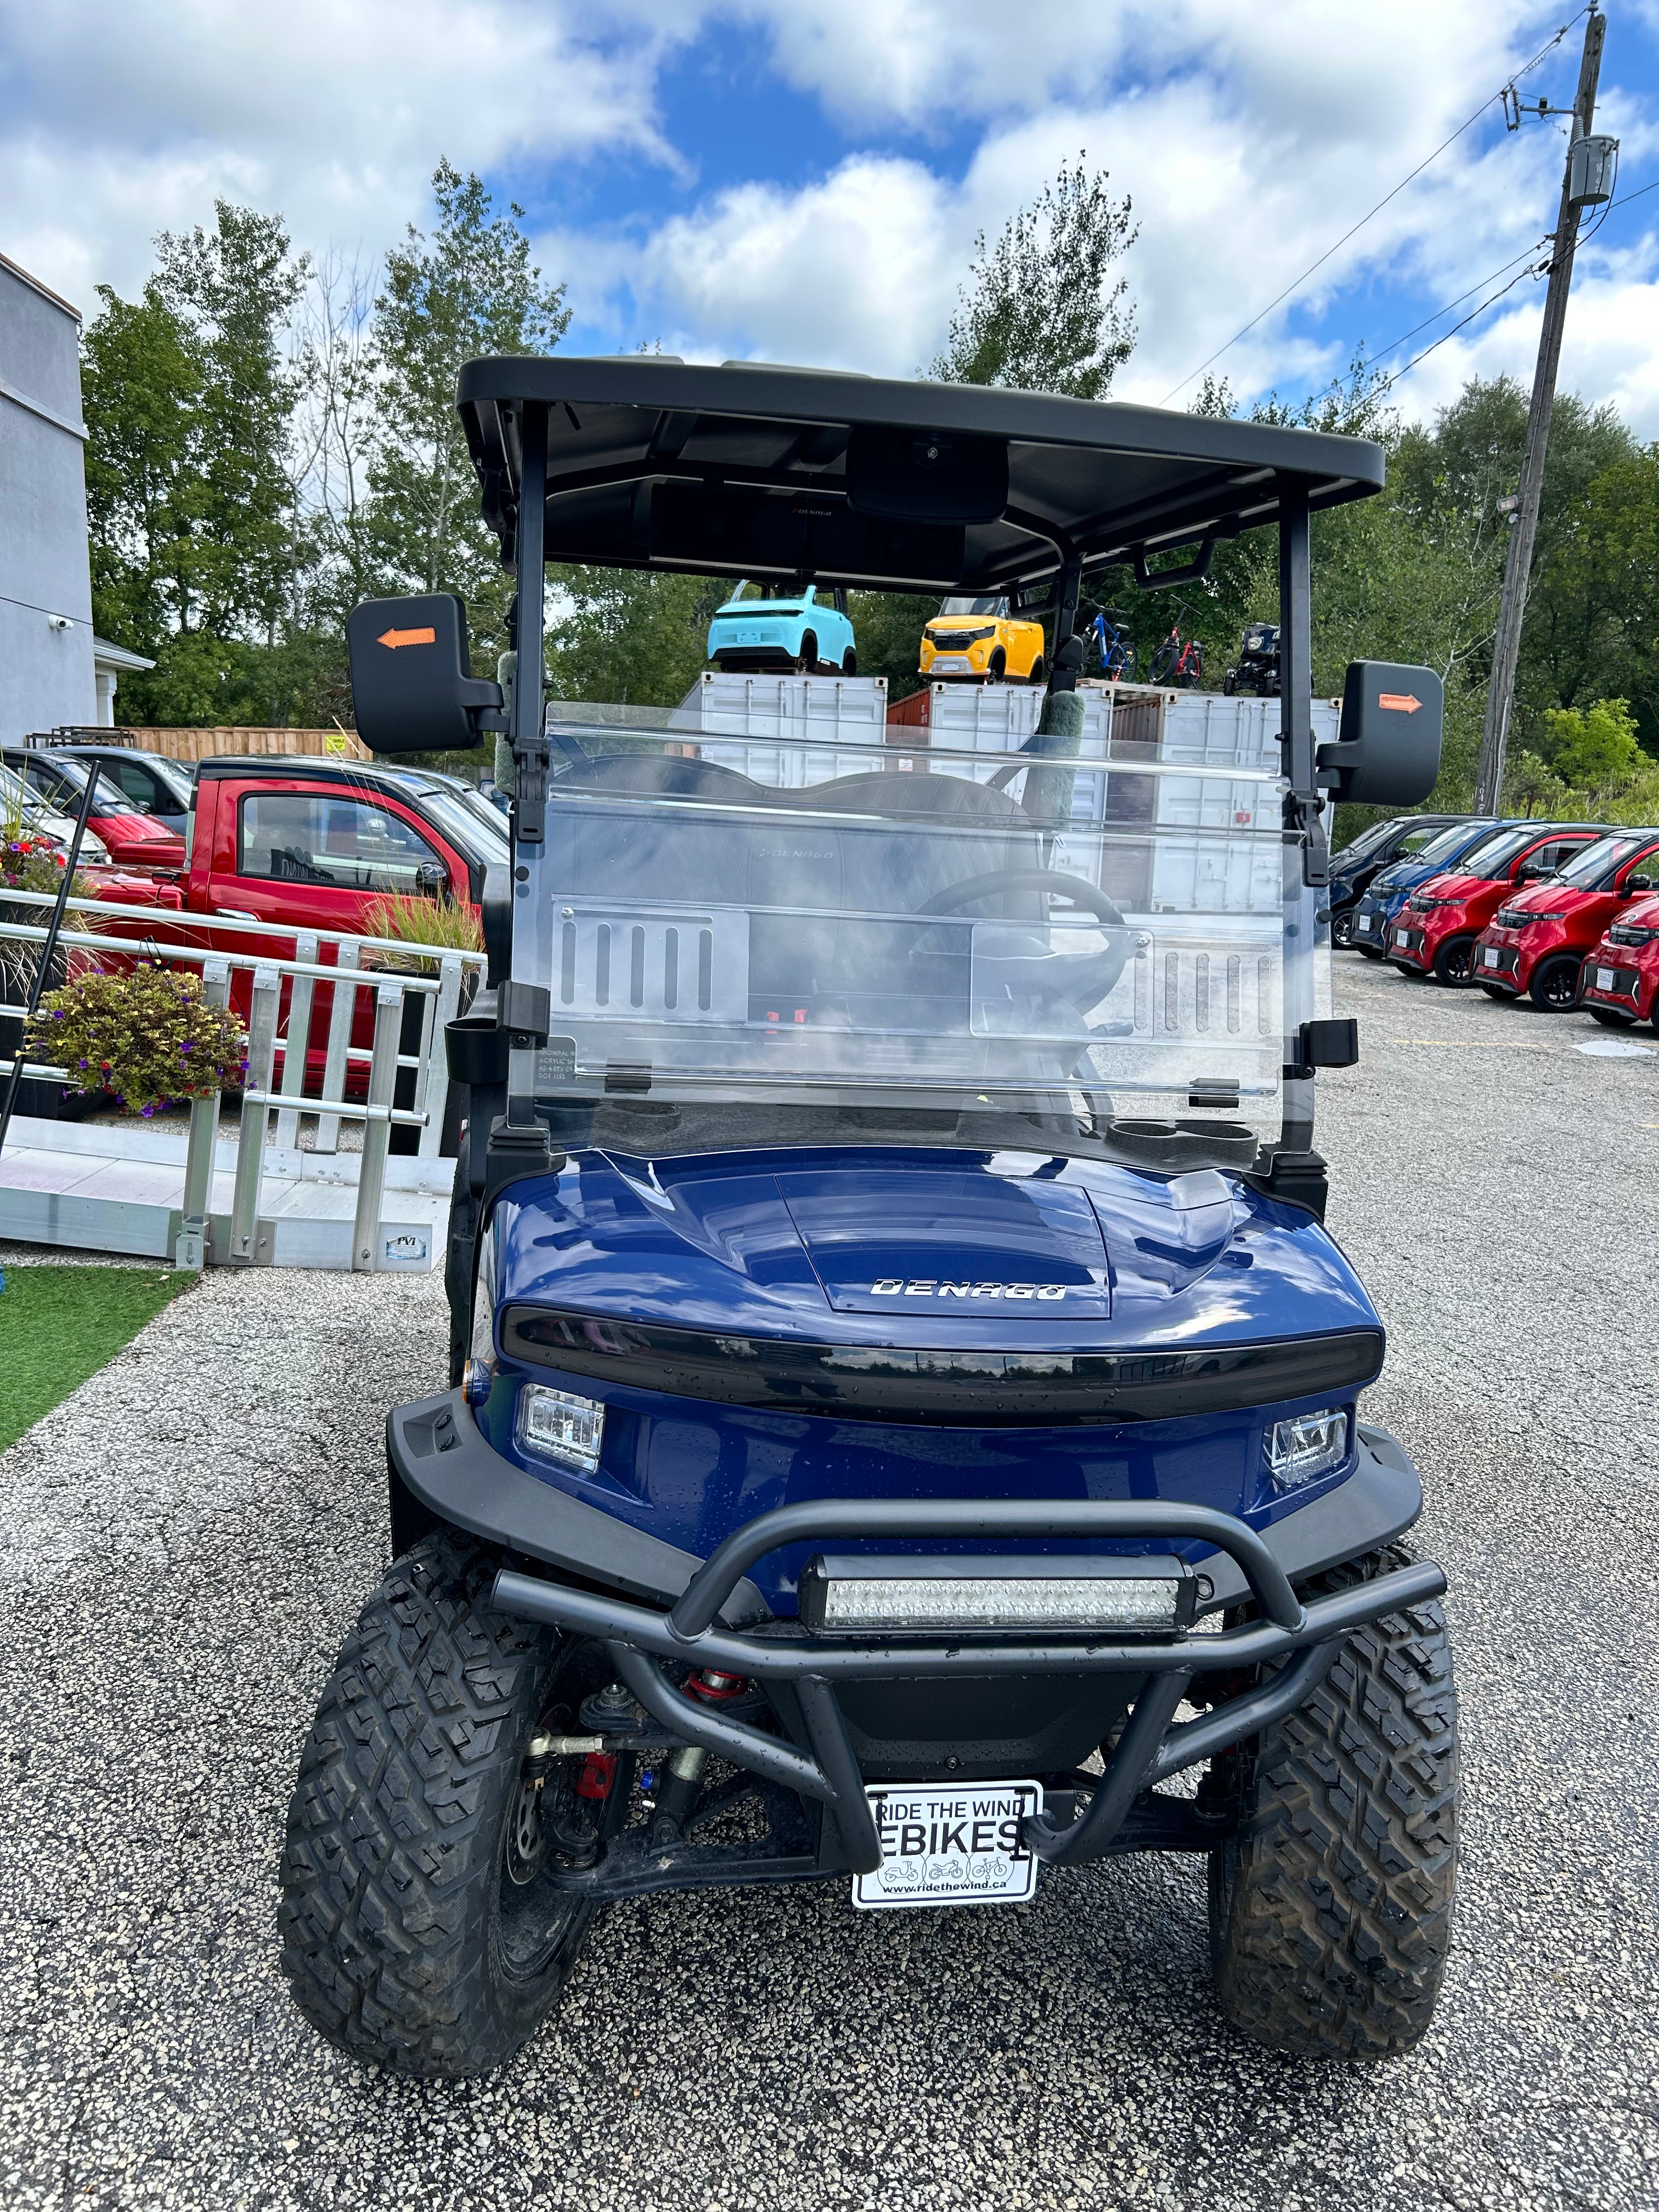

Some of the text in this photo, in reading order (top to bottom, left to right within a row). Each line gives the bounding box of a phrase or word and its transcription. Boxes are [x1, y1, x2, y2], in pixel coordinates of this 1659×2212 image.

[771, 850, 833, 859] DENAGO
[397, 1237, 416, 1246] PVI
[870, 1279, 1066, 1301] DENAGO
[876, 1800, 1025, 1821] RIDE THE WIND
[878, 1820, 1021, 1857] EBIKES
[883, 1881, 1007, 1893] www.ridethewind.ca
